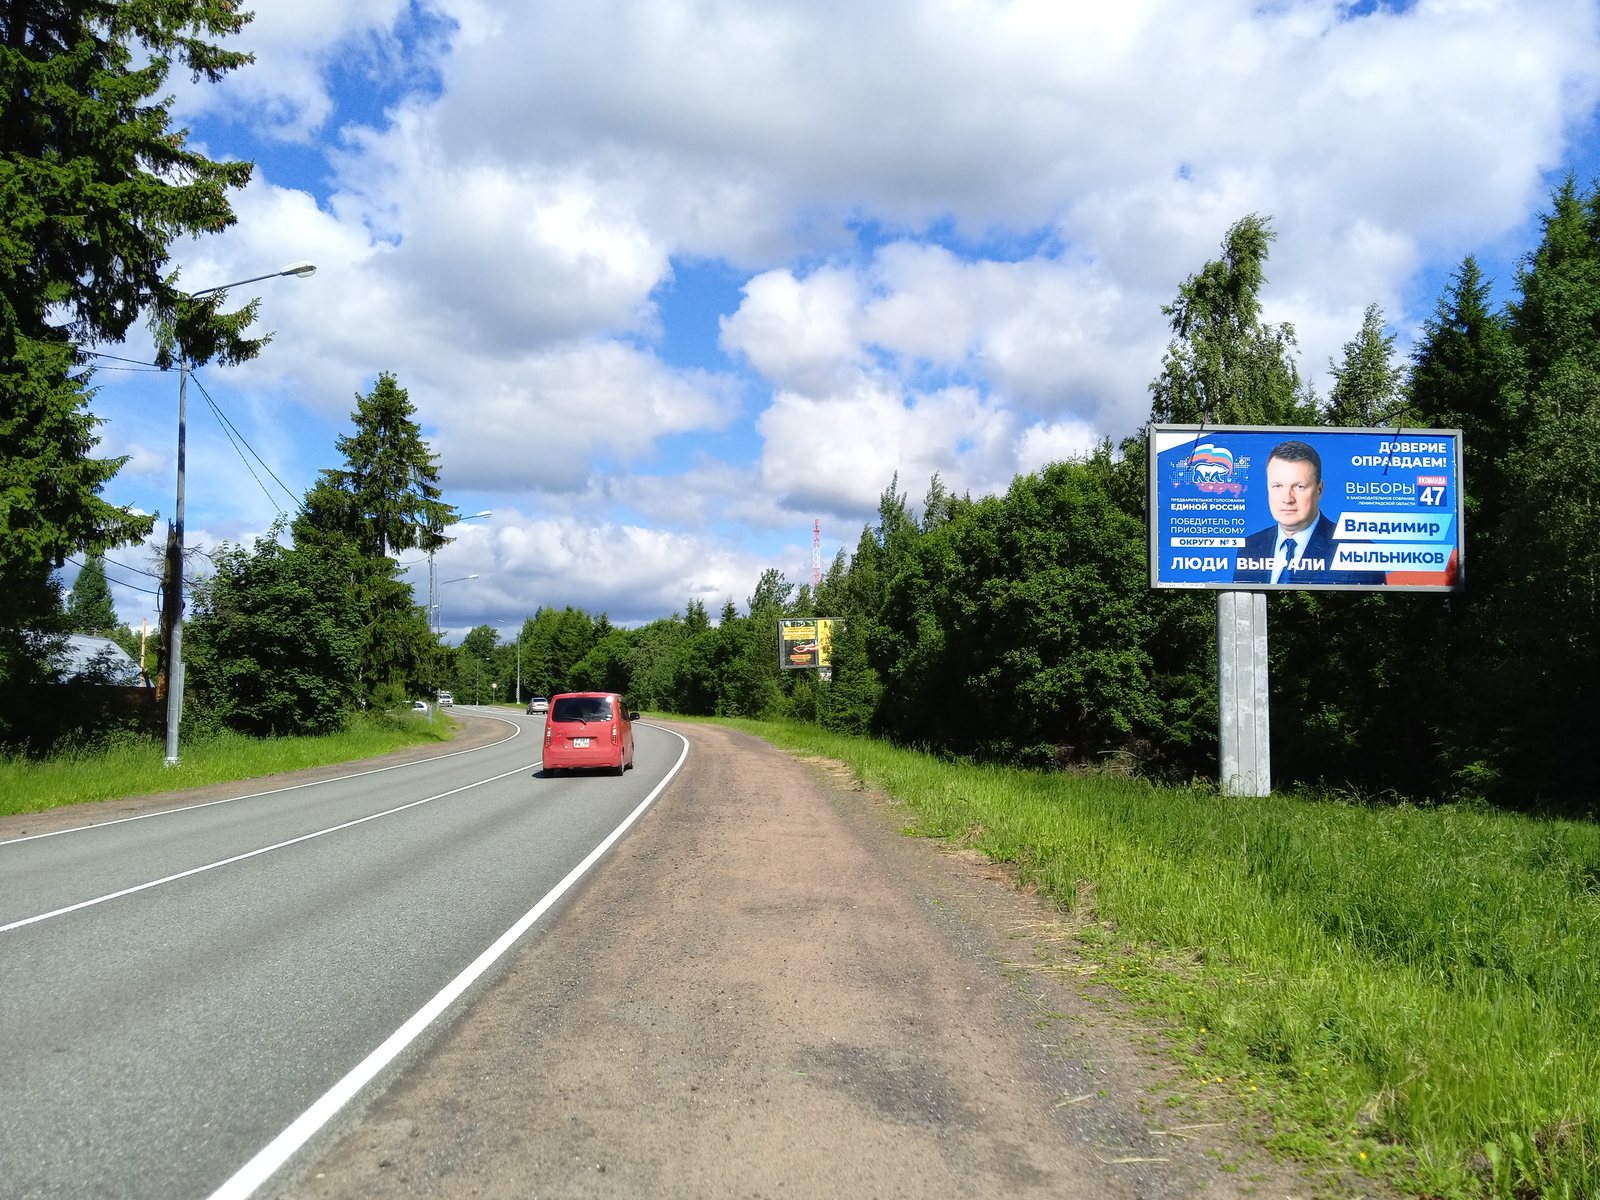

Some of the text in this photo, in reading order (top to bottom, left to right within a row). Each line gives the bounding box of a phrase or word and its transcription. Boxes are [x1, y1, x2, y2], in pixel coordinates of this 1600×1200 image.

[1379, 442, 1447, 455] ДОВЕРИЕ
[1351, 456, 1447, 469] ОПРАВДАЕМ!
[1345, 482, 1415, 495] ВЫБОРЫ
[1419, 486, 1445, 506] 47
[1170, 502, 1246, 511] ЕДИНОЙ РОССИИ
[1170, 517, 1230, 526] ПОБЕДИТЕЛЬ
[1344, 518, 1441, 537] Владимир
[1170, 526, 1246, 535] ПРИОЗЕРСКОМУ
[1179, 538, 1215, 546] ОКРУГУ
[1339, 551, 1445, 564] МЫЛЬНИКОВ
[1170, 557, 1229, 572] ЛЮДИ
